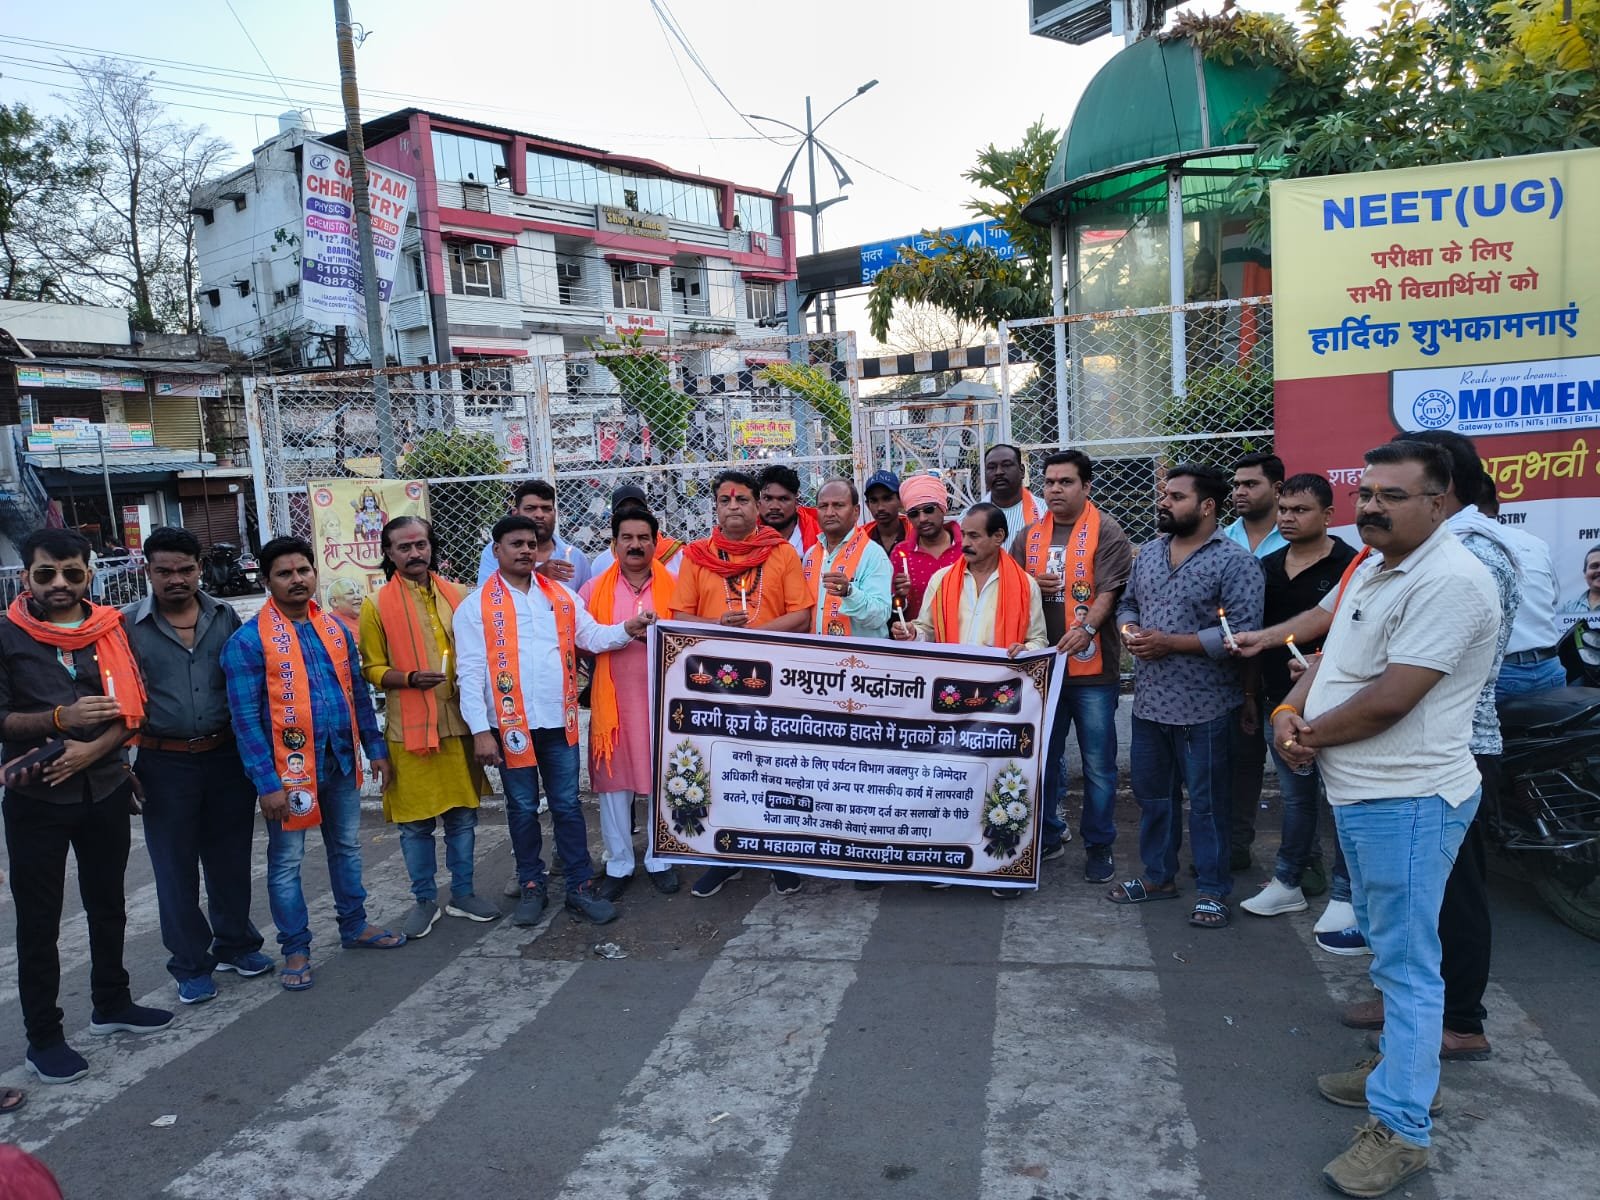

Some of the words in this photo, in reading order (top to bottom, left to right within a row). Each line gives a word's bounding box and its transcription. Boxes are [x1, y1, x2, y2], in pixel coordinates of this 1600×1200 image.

[307, 175, 403, 219] CHEMTRY
[315, 201, 345, 214] PHYSICS
[1323, 177, 1563, 231] NEET(UG)
[308, 217, 349, 234] CHEMISTRY
[353, 228, 394, 249] CERCE
[384, 224, 397, 235] BIO
[375, 248, 394, 261] CUET
[861, 249, 883, 262] सदर
[1372, 244, 1433, 268] परीक्षा
[1440, 240, 1462, 264] के
[1472, 237, 1514, 264] लिए
[1347, 278, 1391, 304] सभी
[1400, 270, 1503, 301] विद्यार्थियों
[1509, 266, 1539, 293] को
[1308, 314, 1400, 354] हार्दिक
[1408, 302, 1579, 356] शुभकामनाएं
[1460, 370, 1497, 386] Realise
[1499, 374, 1520, 387] your
[1428, 392, 1452, 406] GYAN
[1419, 412, 1451, 426] MANDIR
[1458, 423, 1492, 432] Gateway
[1494, 421, 1502, 429] to
[1504, 420, 1519, 428] IITs
[1526, 418, 1544, 427] NITs
[1574, 415, 1592, 423] BITs
[324, 537, 344, 569] श्री
[780, 668, 846, 696] अश्रुपूर्ण
[851, 674, 926, 698] श्रद्धांजली
[284, 706, 296, 724] दल
[691, 707, 722, 728] बरगी
[726, 713, 751, 735] क्रूज
[754, 710, 768, 730] के
[850, 720, 884, 742] हादसे
[886, 722, 897, 742] में
[899, 725, 936, 748] मृतकों
[938, 726, 956, 746] को
[959, 726, 1016, 750] श्रद्धांजलि!
[732, 750, 752, 762] बरगी
[774, 755, 798, 768] हादसे
[800, 756, 810, 768] के
[812, 756, 829, 771] लिए
[832, 759, 856, 772] पर्यटन
[858, 760, 884, 775] विभाग
[887, 764, 920, 780] जबलपुर
[922, 765, 931, 778] के
[933, 766, 968, 781] जिम्मेदार
[721, 768, 758, 782] अधिकारी
[760, 774, 782, 786] संजय
[784, 776, 814, 790] मल्होत्रा
[817, 779, 830, 792] एवं
[832, 781, 850, 792] अन्य
[854, 783, 864, 794] पर
[867, 782, 902, 796] शासकीय
[905, 786, 924, 799] कार्य
[926, 786, 934, 799] में
[935, 787, 974, 800] लापरवाही
[723, 790, 749, 804] बरतने,
[752, 792, 764, 804] एवं
[767, 795, 795, 808] मृतकों
[798, 796, 811, 809] की
[815, 800, 833, 812] हत्या
[836, 802, 847, 814] का
[850, 804, 876, 816] प्रकरण
[878, 804, 892, 818] दर्ज
[894, 808, 907, 818] कर
[910, 806, 941, 818] सलाखों
[942, 808, 952, 820] के
[954, 808, 970, 820] पीछे
[763, 810, 781, 824] भेजा
[784, 815, 800, 827] जाए
[802, 814, 818, 828] और
[820, 818, 842, 831] उसकी
[845, 820, 868, 836] सेवाएं
[869, 824, 896, 836] समाप्त
[898, 824, 908, 836] की
[737, 837, 760, 850] जय
[763, 837, 816, 854] महाकाल
[819, 840, 842, 856] संघ
[844, 843, 904, 863] अंतरराष्ट्रीय
[906, 848, 942, 862] बजरंग
[945, 852, 966, 864] दल
